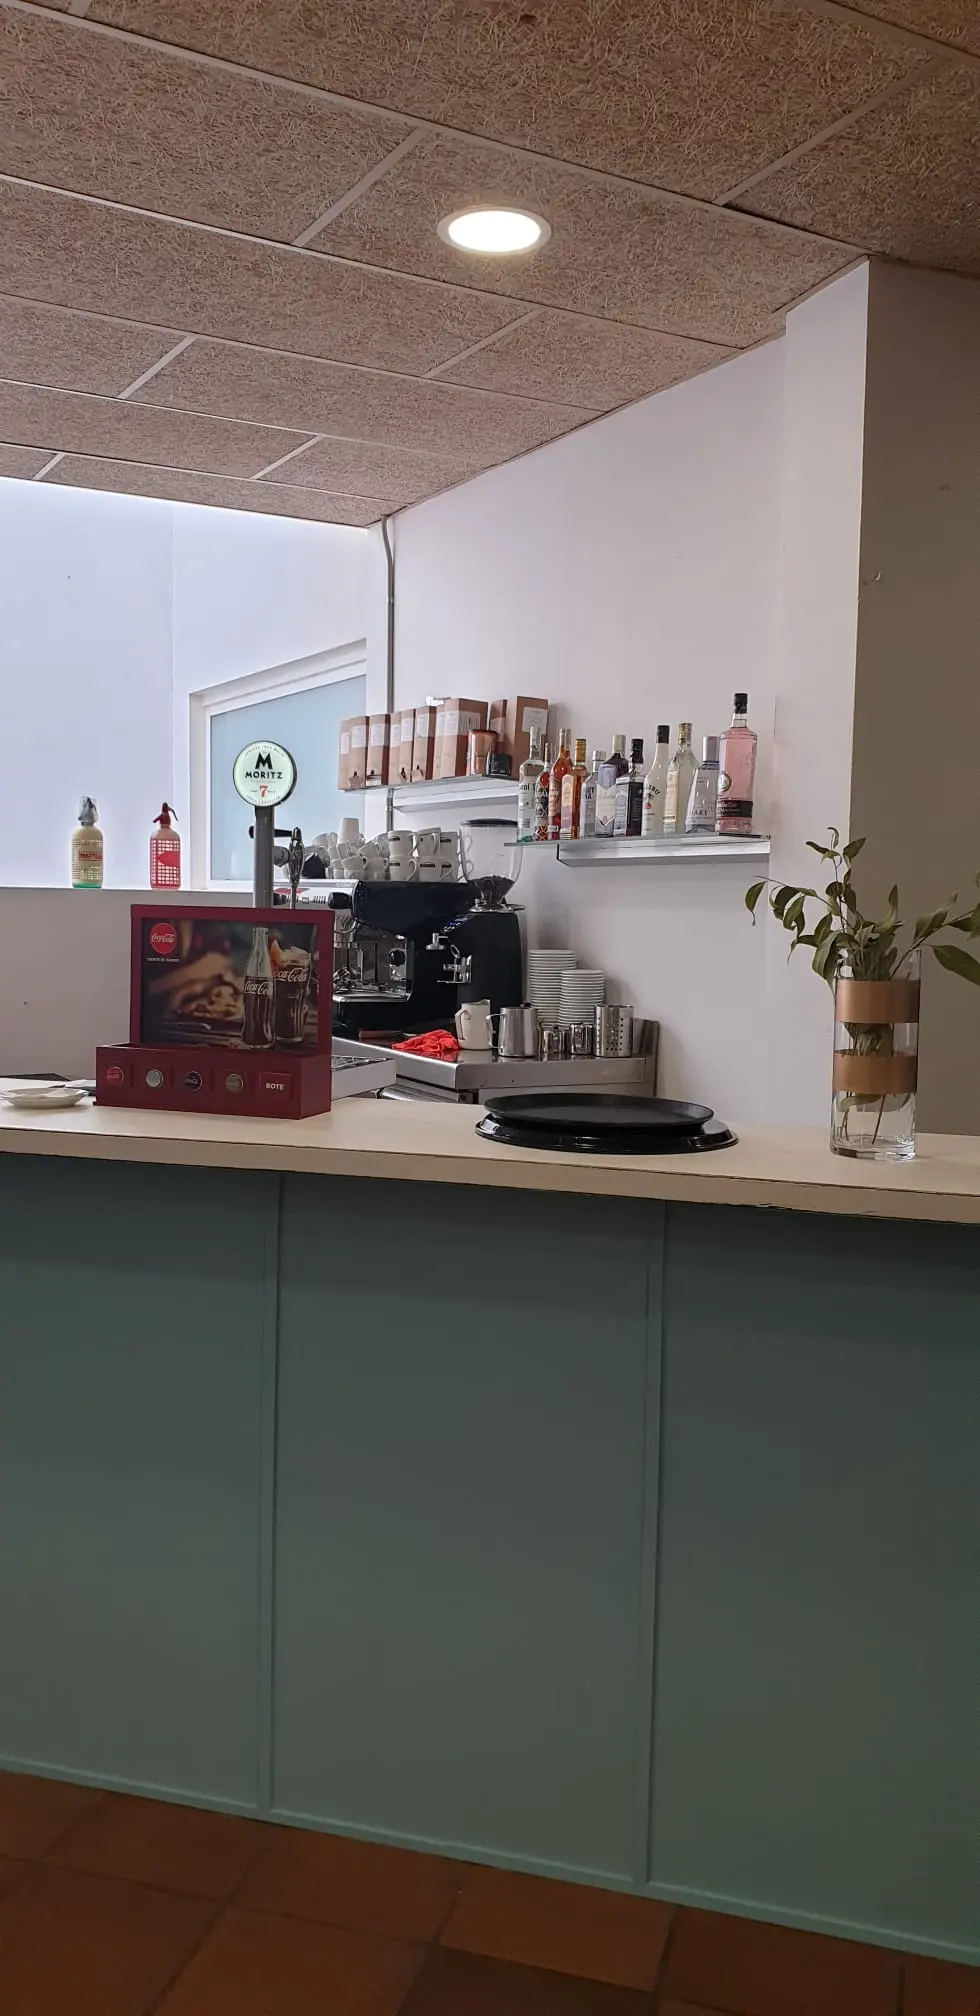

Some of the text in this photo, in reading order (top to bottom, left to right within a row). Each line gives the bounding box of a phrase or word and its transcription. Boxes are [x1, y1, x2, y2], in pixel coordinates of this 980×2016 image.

[255, 752, 273, 769] M
[245, 771, 282, 779] MORITZ
[259, 785, 268, 798] 7
[265, 1082, 284, 1091] BOTE
